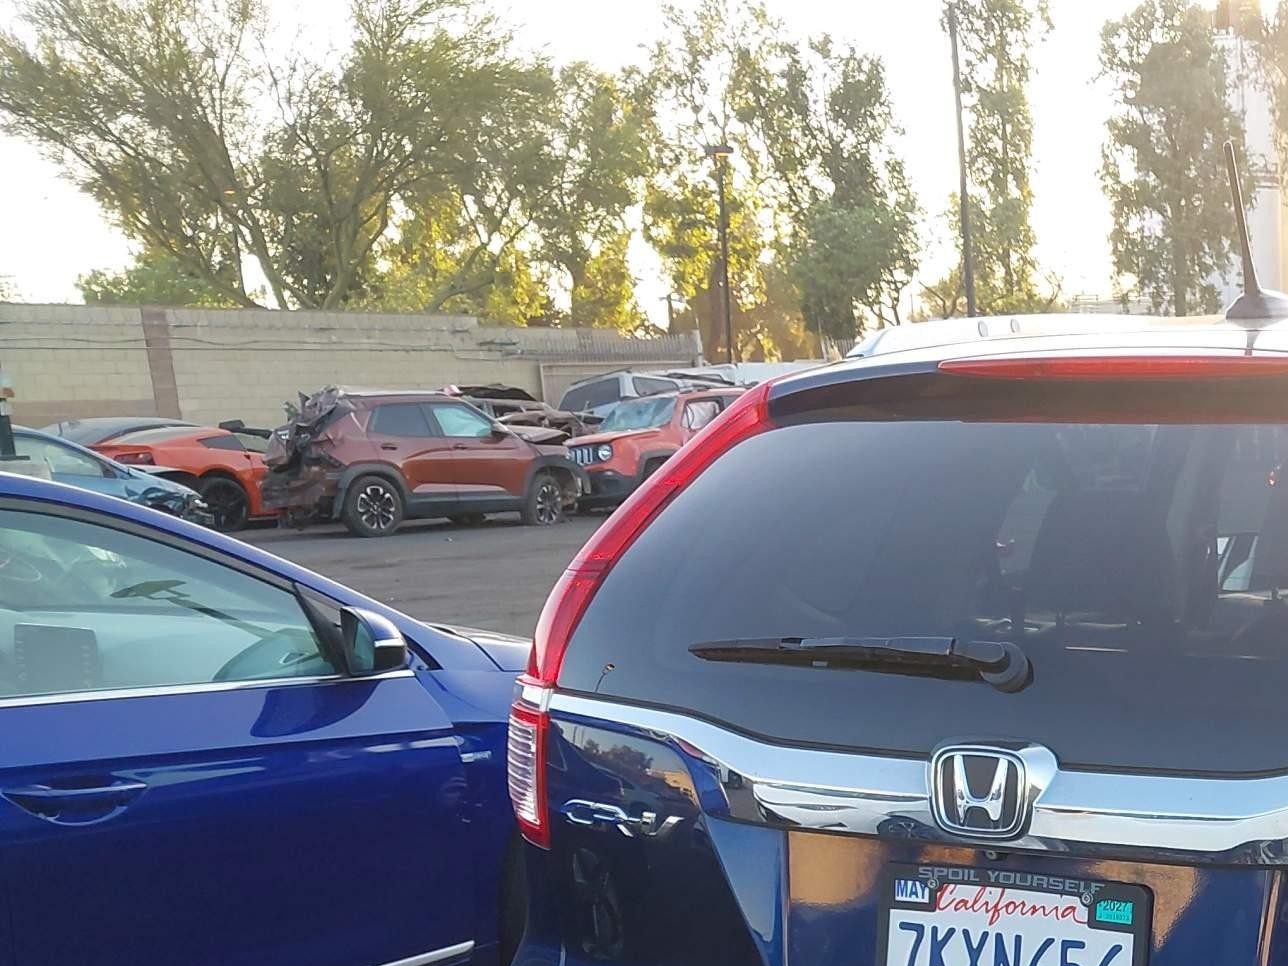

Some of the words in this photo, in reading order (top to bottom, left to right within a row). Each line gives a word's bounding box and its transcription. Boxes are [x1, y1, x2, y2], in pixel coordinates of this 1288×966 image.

[918, 866, 980, 882] SPOIL
[896, 880, 927, 900] MAY
[935, 883, 1088, 926] California
[1103, 898, 1128, 912] 2027
